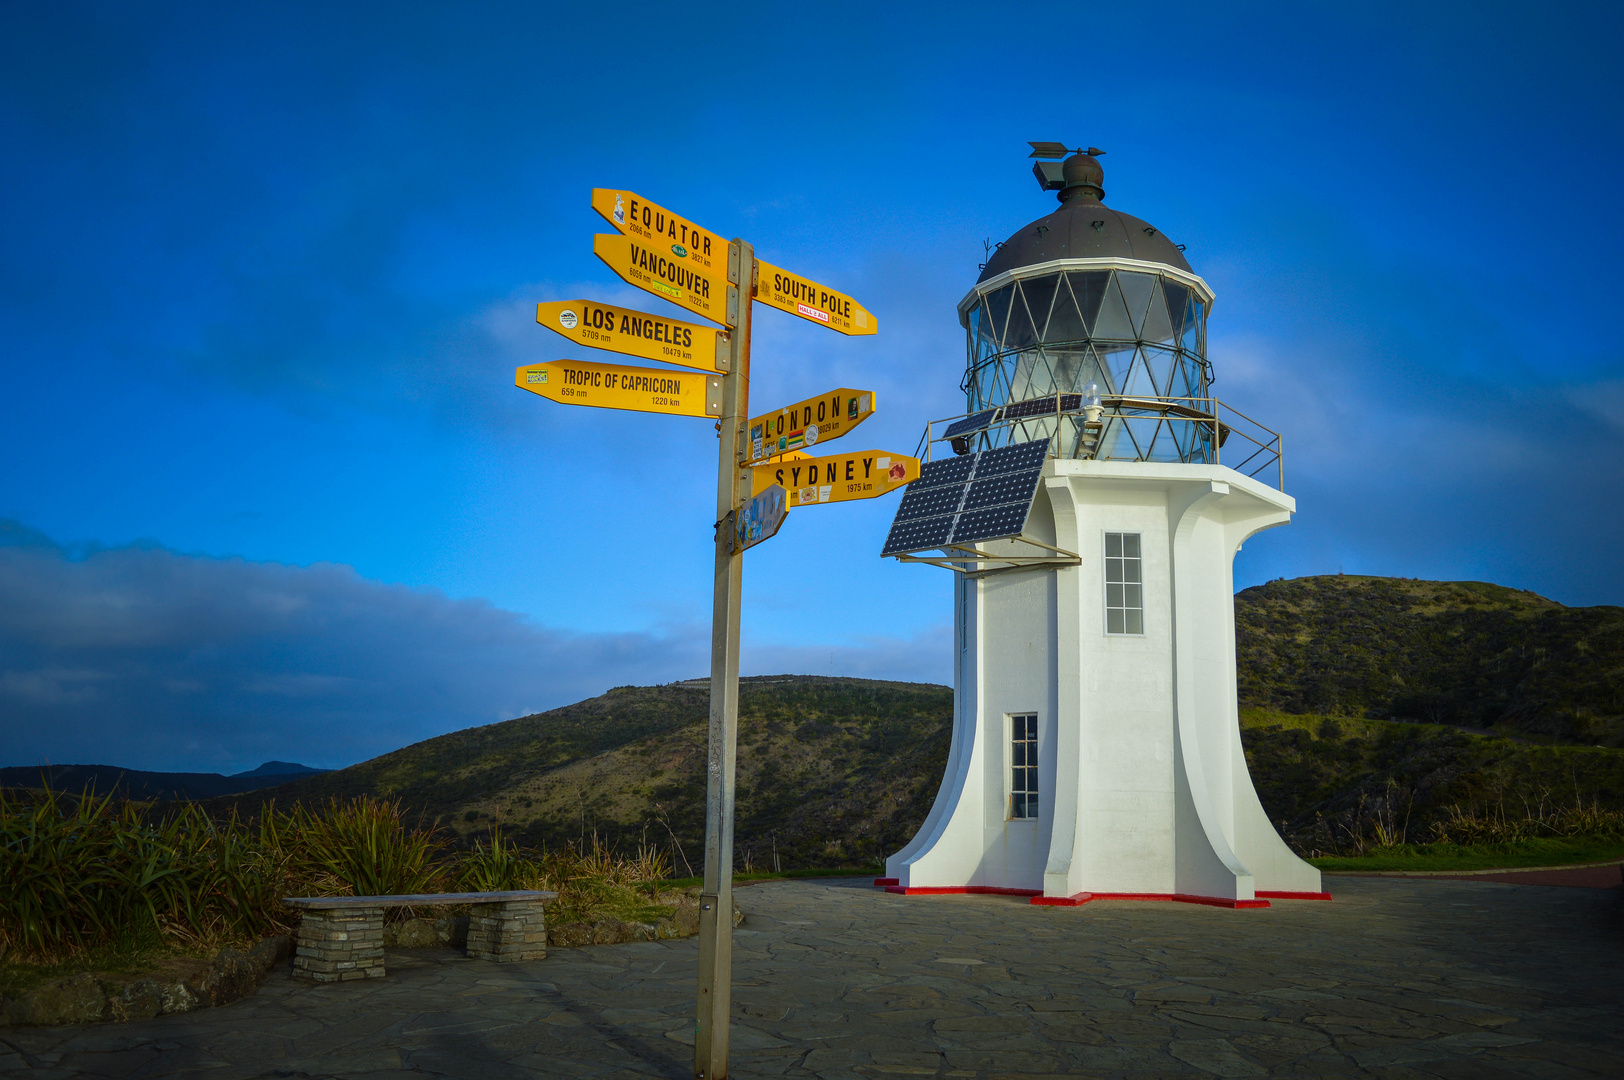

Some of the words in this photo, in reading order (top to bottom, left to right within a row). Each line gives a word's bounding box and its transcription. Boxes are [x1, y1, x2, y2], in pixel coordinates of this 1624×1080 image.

[629, 222, 642, 235] 2066
[644, 230, 651, 239] nm
[630, 199, 711, 257] EQUATOR
[691, 252, 703, 264] 3827
[704, 258, 711, 267] km
[629, 267, 642, 280] 6059
[643, 275, 651, 284] nm
[630, 243, 709, 299] VANCOUVER
[688, 294, 701, 307] 11222
[703, 300, 709, 310] km
[774, 273, 815, 305] SOUTH
[821, 292, 850, 318] POLE
[774, 293, 786, 303] 3383
[799, 306, 812, 315] HALL
[818, 312, 827, 320] ALL
[583, 306, 614, 331] LOS
[619, 315, 692, 348] ANGELES
[831, 316, 842, 325] 6211
[843, 320, 850, 328] km
[582, 329, 599, 340] 5709
[601, 334, 611, 342] nm
[662, 346, 680, 358] 10479
[682, 351, 692, 359] km
[564, 369, 601, 387] TROPIC
[605, 373, 618, 388] OF
[621, 375, 680, 395] CAPRICORN
[561, 388, 574, 396] 659
[652, 397, 667, 405] 1220
[669, 398, 679, 406] km
[765, 396, 840, 439] LONDON
[832, 422, 839, 430] km
[775, 458, 873, 486] SYDNEY
[847, 484, 861, 492] 1975
[863, 483, 872, 491] km
